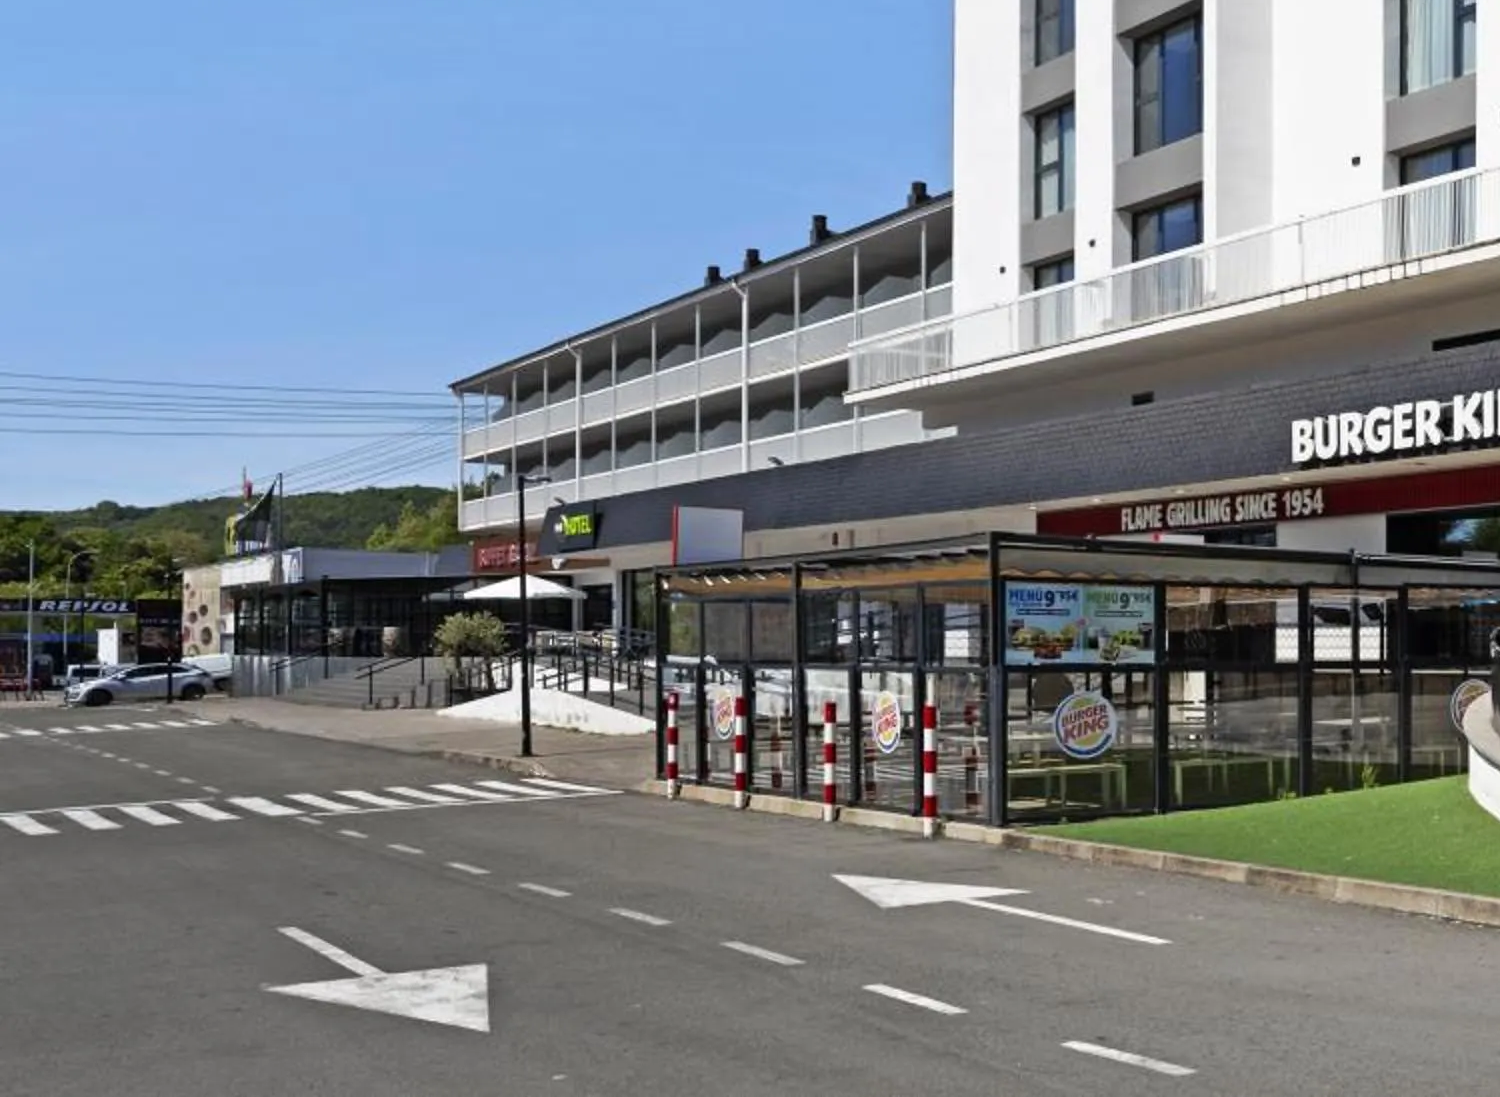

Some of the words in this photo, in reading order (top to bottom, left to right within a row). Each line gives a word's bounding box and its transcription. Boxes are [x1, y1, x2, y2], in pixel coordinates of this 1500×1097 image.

[1291, 400, 1442, 464] BURGER
[1121, 503, 1163, 532] FLAME
[1166, 497, 1231, 527] GRILLING
[1235, 492, 1277, 522] SINCE
[1282, 487, 1325, 518] 1954
[1063, 715, 1109, 744] KING
